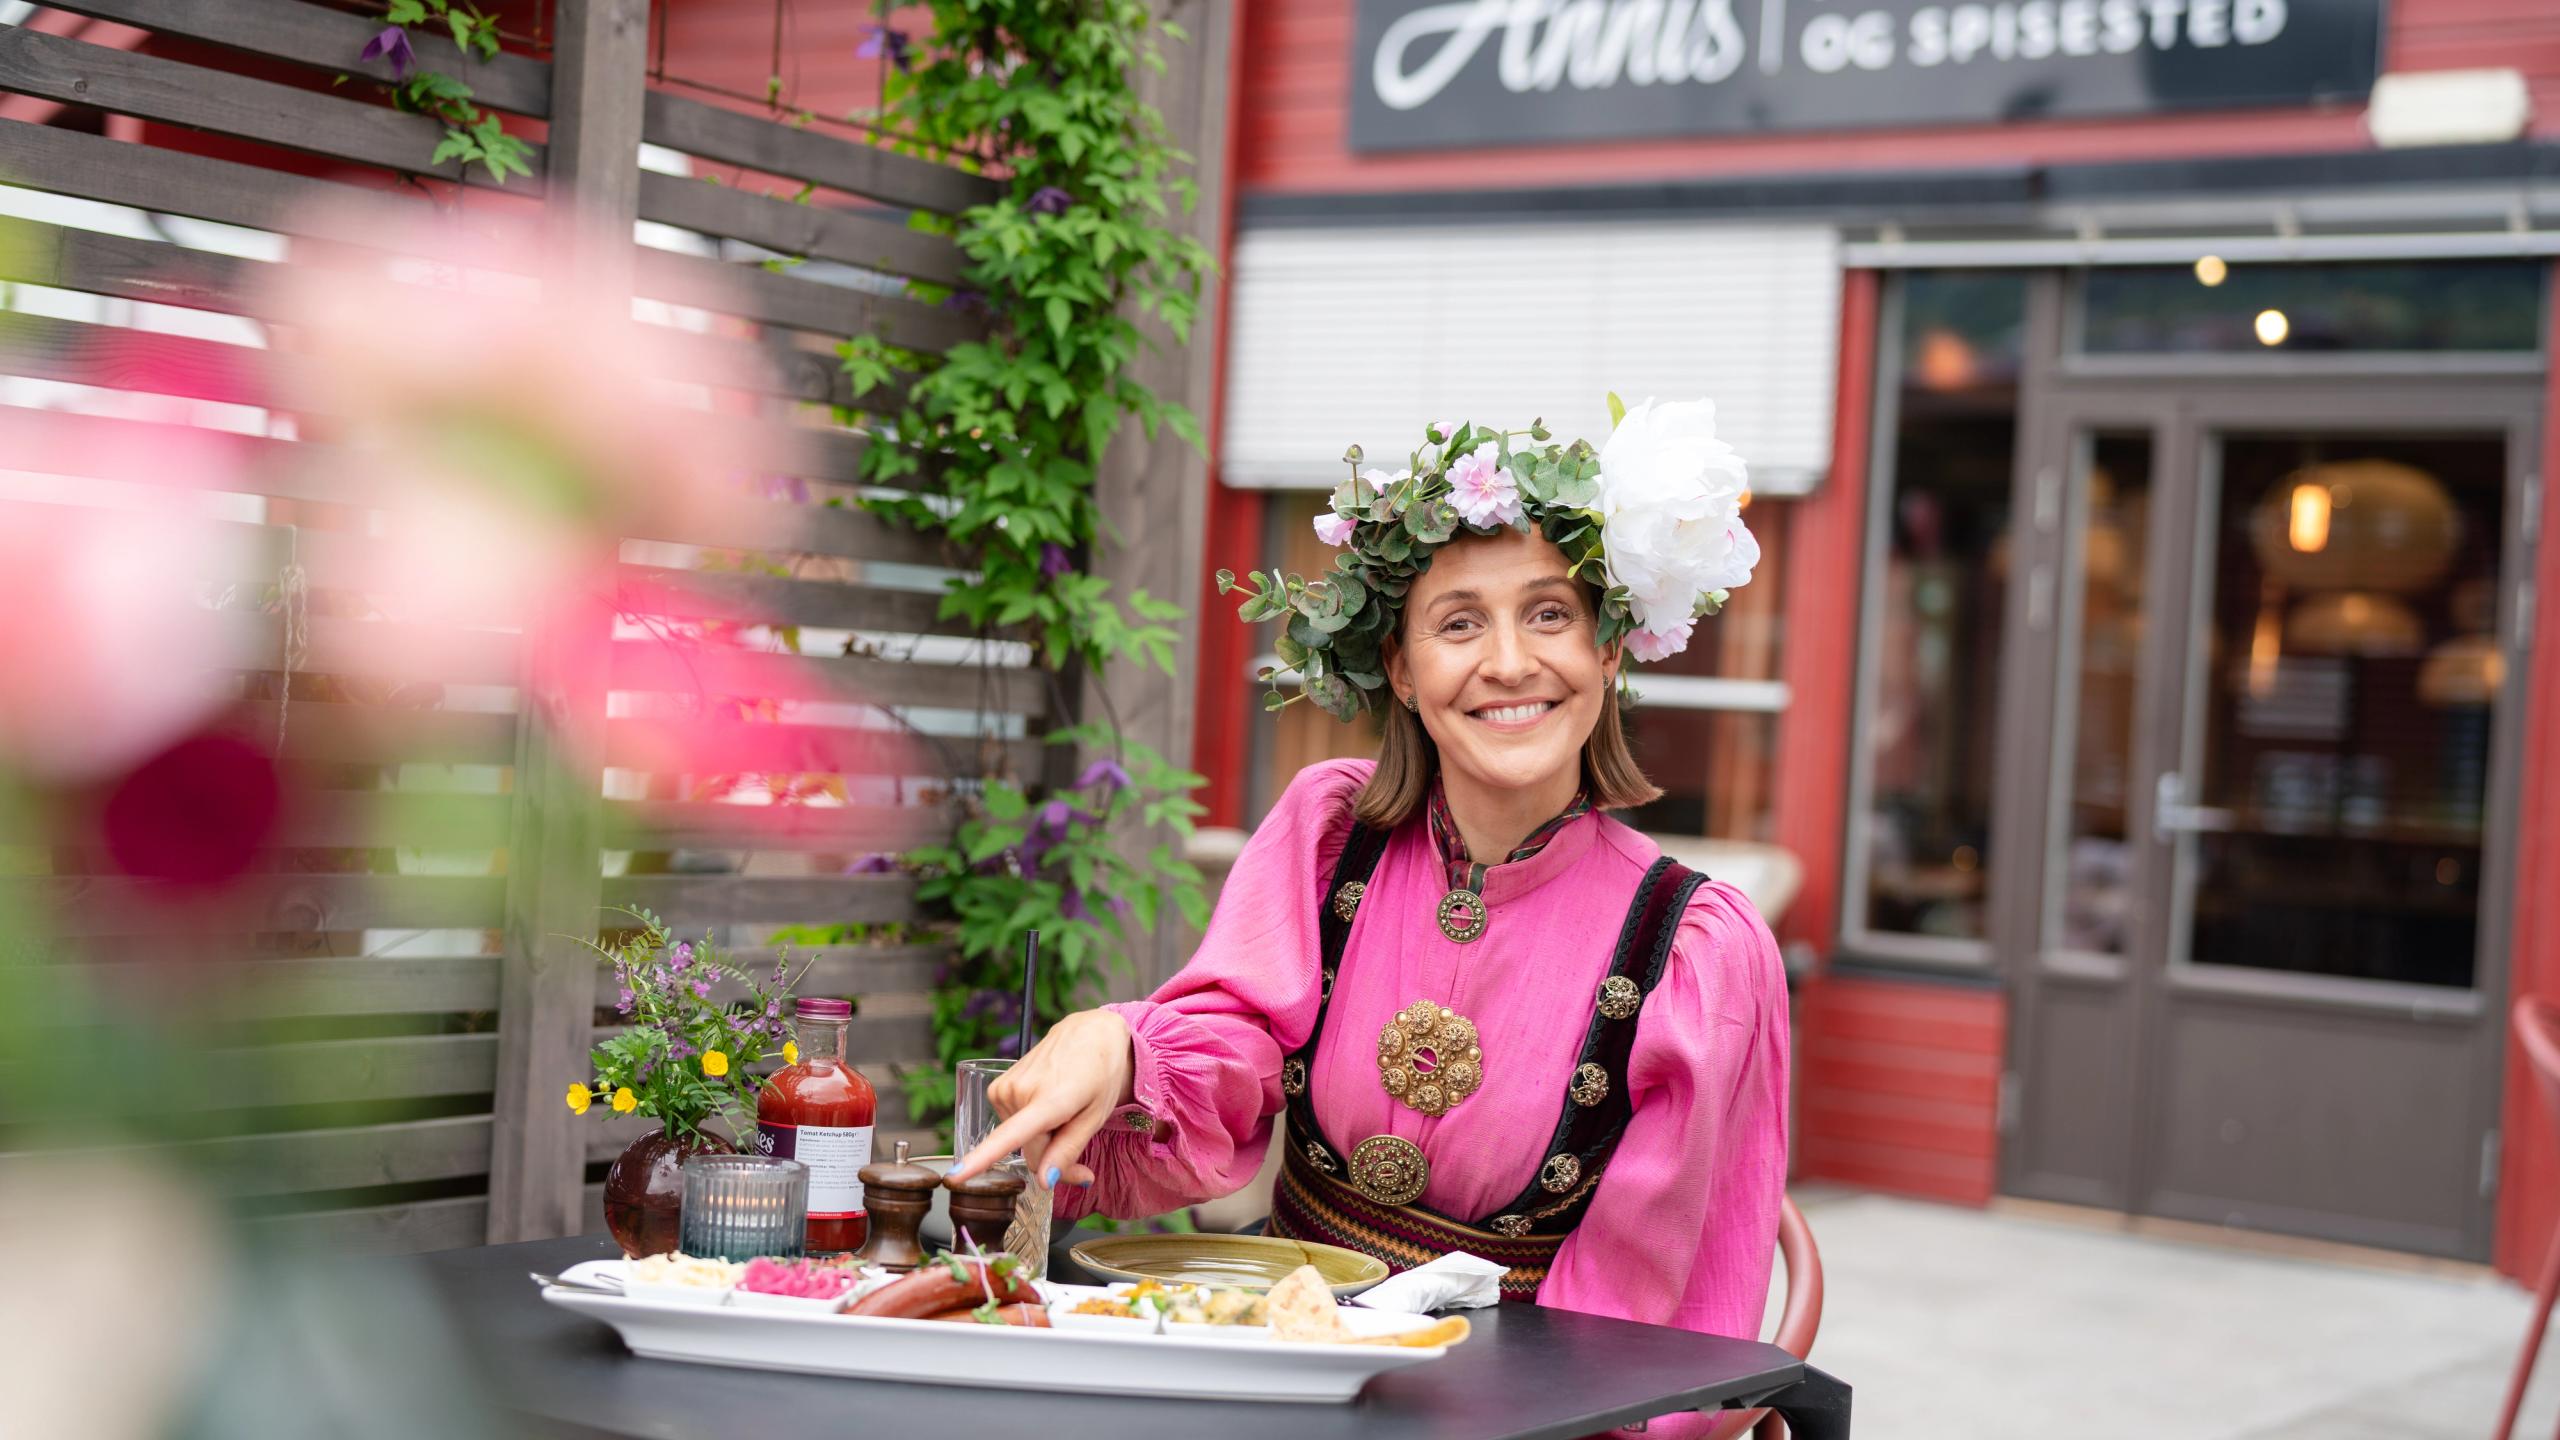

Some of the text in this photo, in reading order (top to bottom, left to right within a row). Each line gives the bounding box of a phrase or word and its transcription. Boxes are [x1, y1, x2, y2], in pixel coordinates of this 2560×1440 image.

[1801, 0, 2288, 74] OG SPISESTED
[800, 1129, 818, 1137] Tomat
[819, 1131, 842, 1139] Ketchup
